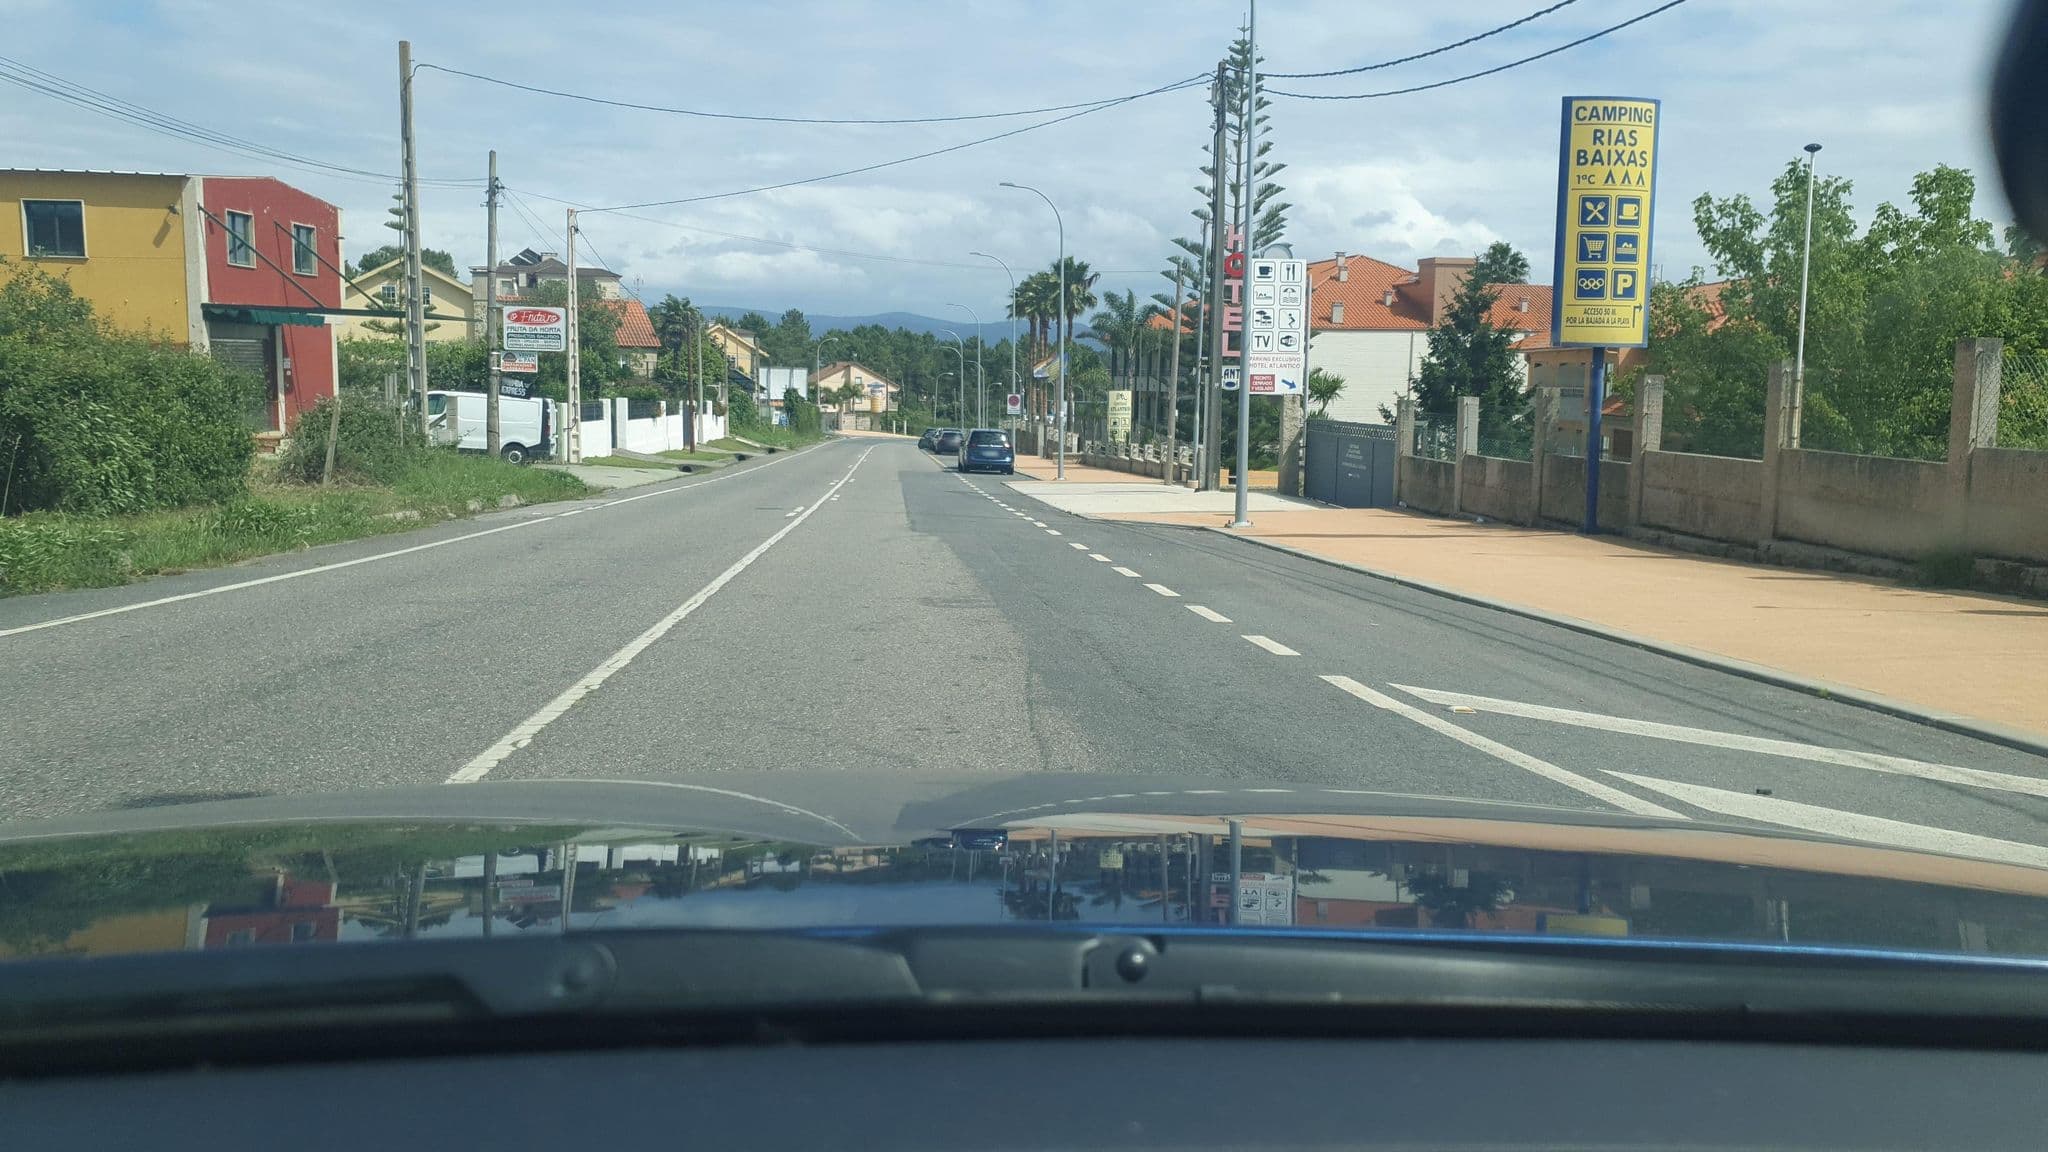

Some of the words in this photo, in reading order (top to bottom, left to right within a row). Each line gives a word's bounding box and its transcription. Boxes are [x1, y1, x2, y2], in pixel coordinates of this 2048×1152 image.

[1575, 105, 1653, 123] CAMPING
[1592, 128, 1638, 147] RIAS
[1576, 149, 1648, 168] BAIXAS
[1222, 224, 1245, 357] HOTEL
[1617, 273, 1633, 295] P
[1584, 307, 1603, 316] ACCESO
[1254, 335, 1271, 348] TV
